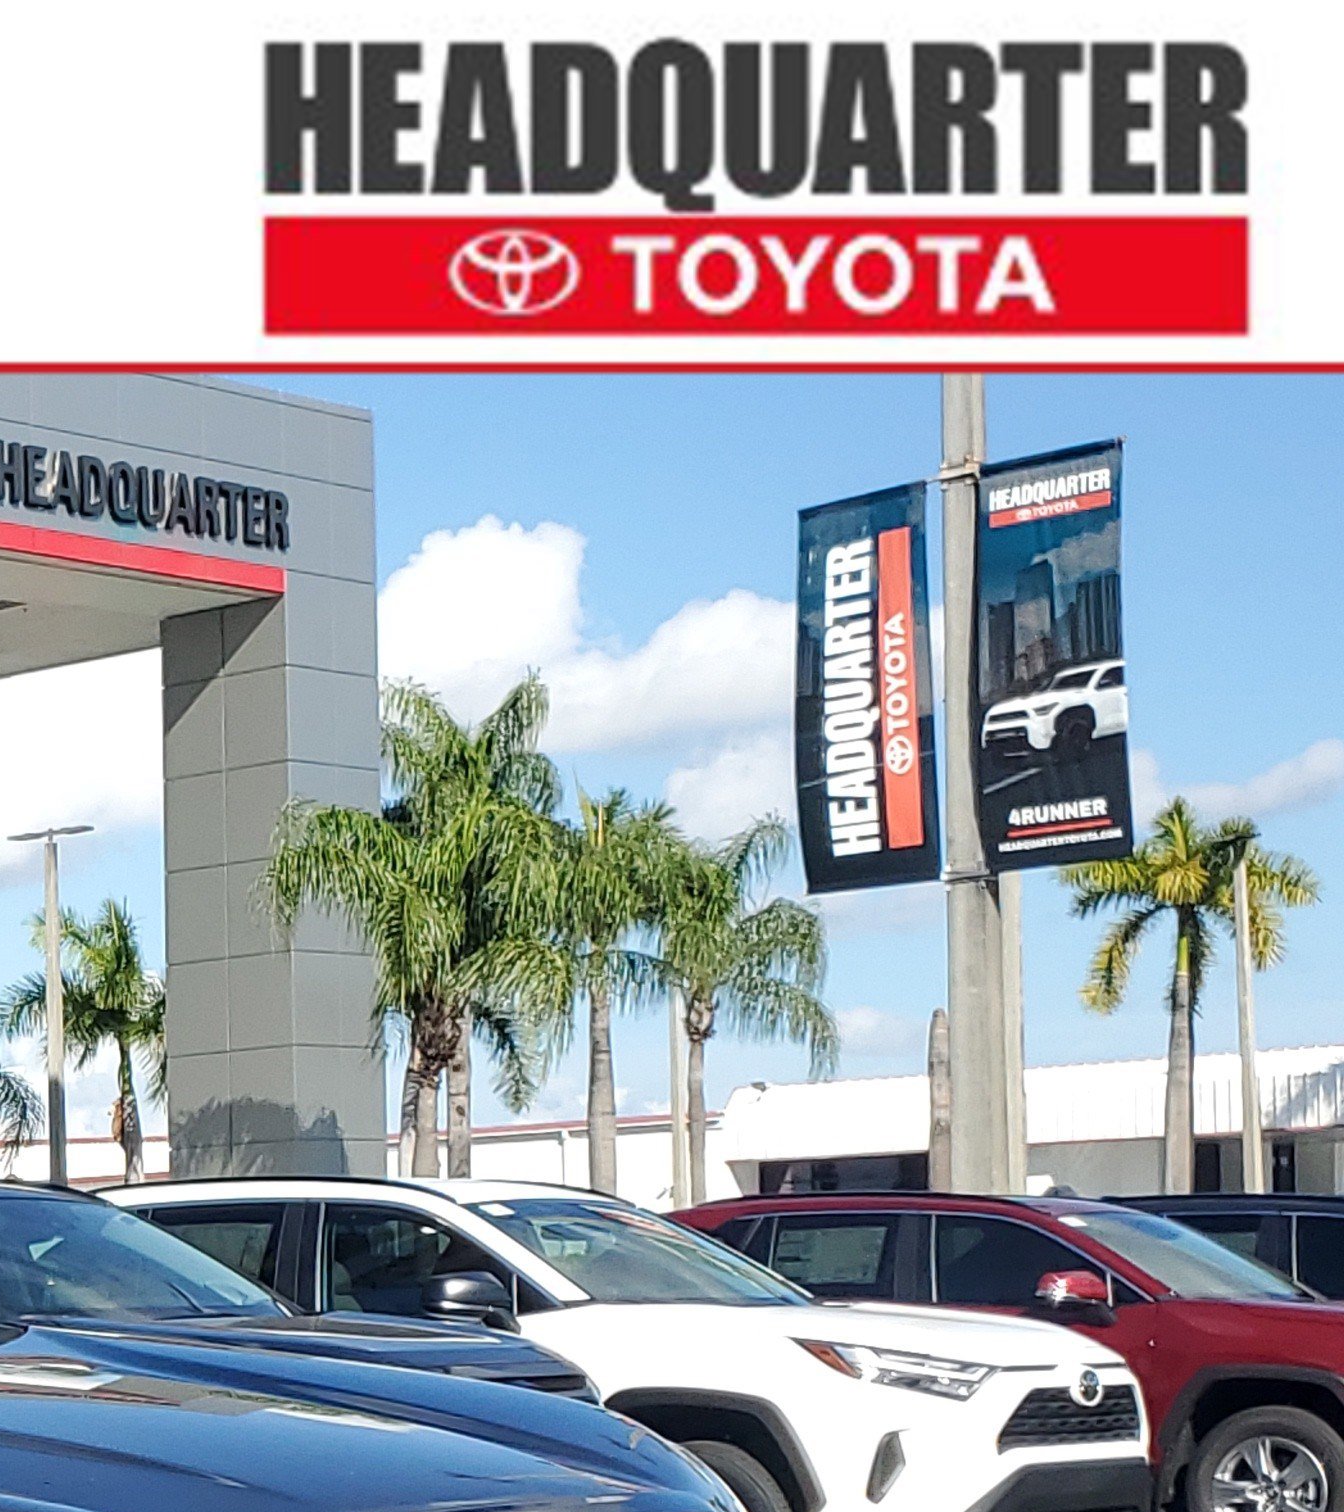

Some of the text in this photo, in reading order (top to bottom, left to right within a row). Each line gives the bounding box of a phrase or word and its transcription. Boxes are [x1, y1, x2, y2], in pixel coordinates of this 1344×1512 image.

[989, 468, 1111, 511] HEADQUARTER
[1032, 500, 1080, 517] TOYOTA
[884, 612, 910, 734] TOYOTA
[824, 537, 882, 857] HEADQUARTER
[1008, 797, 1109, 826] 4RUNNER
